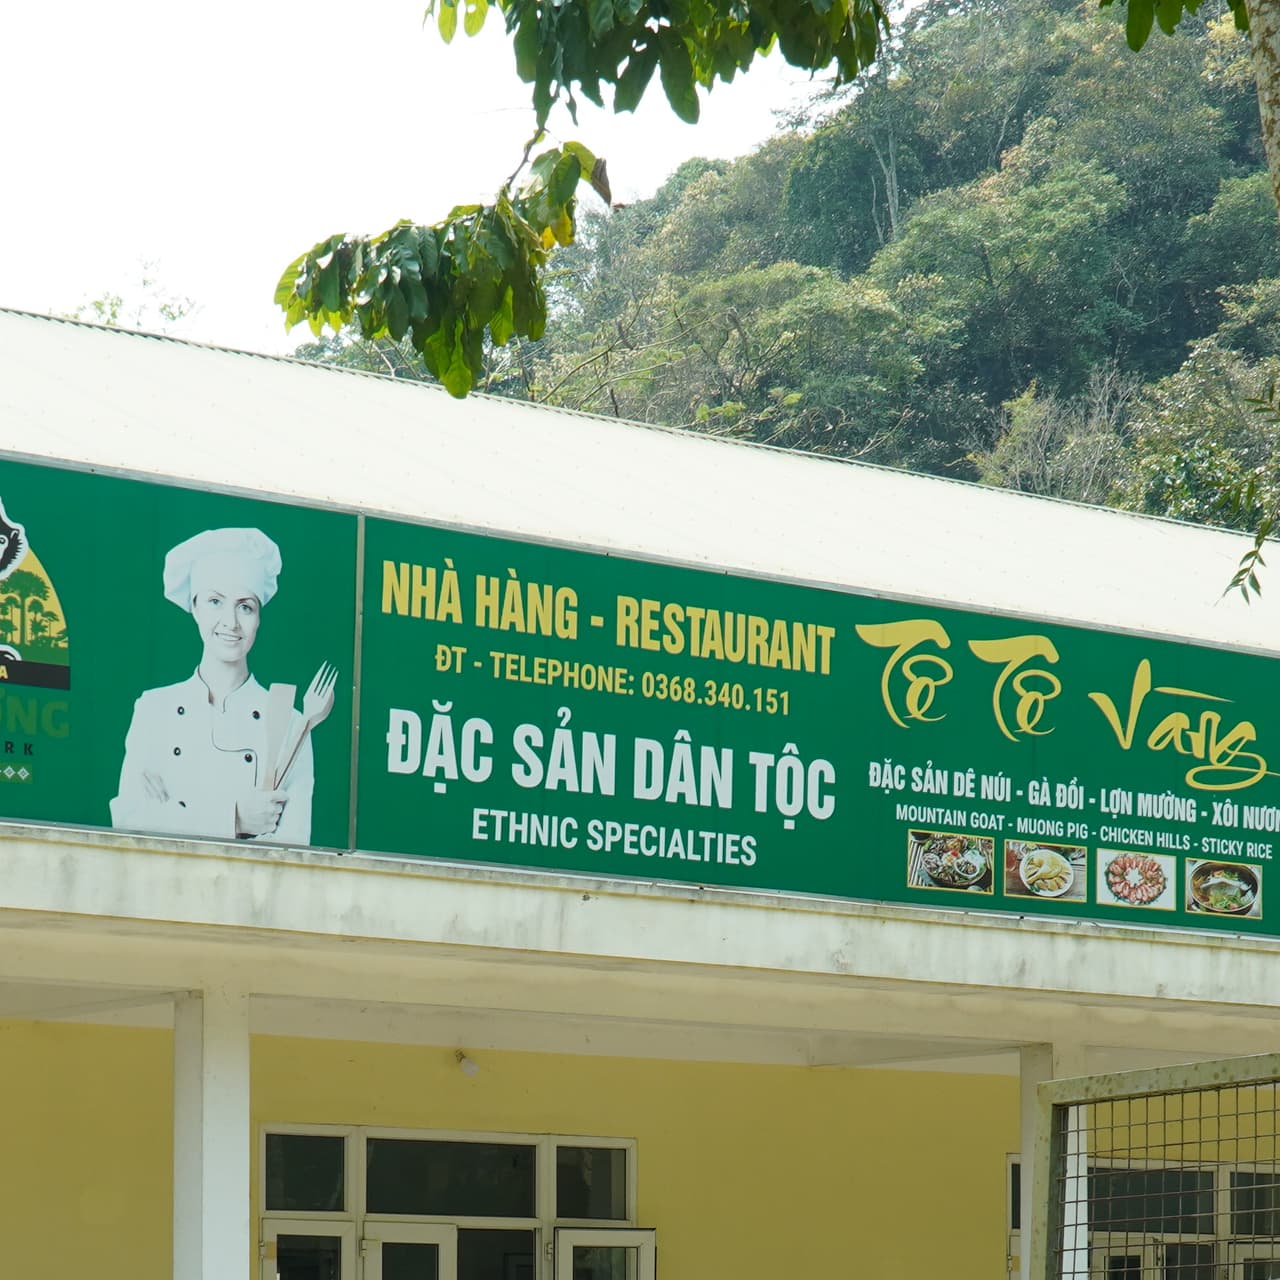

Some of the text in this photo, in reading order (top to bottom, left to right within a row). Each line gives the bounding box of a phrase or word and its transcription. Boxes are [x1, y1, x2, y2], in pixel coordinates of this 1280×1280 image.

[380, 558, 836, 676] NHÀ HÀNG - RESTAURANT
[434, 643, 467, 674] ĐT
[489, 650, 636, 696] TELEPHONE:
[641, 671, 790, 716] 0368.340.151
[385, 699, 837, 831] ĐẶC SẢN DÂN TỘC
[868, 757, 907, 795] ĐẶC
[911, 759, 949, 796] SẢN
[953, 767, 976, 799] DÊ
[981, 771, 1012, 802] NÚI
[1028, 776, 1052, 807] GÀ
[1100, 787, 1132, 819] LỢN
[1137, 790, 1197, 823] MƯỜNG
[1212, 798, 1239, 828] XÔI
[472, 807, 758, 867] ETHNIC SPECIALTIES
[895, 803, 967, 828] MOUNTAIN
[970, 811, 1006, 832] GOAT
[1016, 816, 1064, 838] MUONG
[1067, 820, 1089, 840] PIG
[1100, 825, 1154, 847] CHICKEN
[1156, 831, 1191, 850] HILLS
[1201, 836, 1245, 858] STICKY
[1246, 842, 1273, 860] RICE
